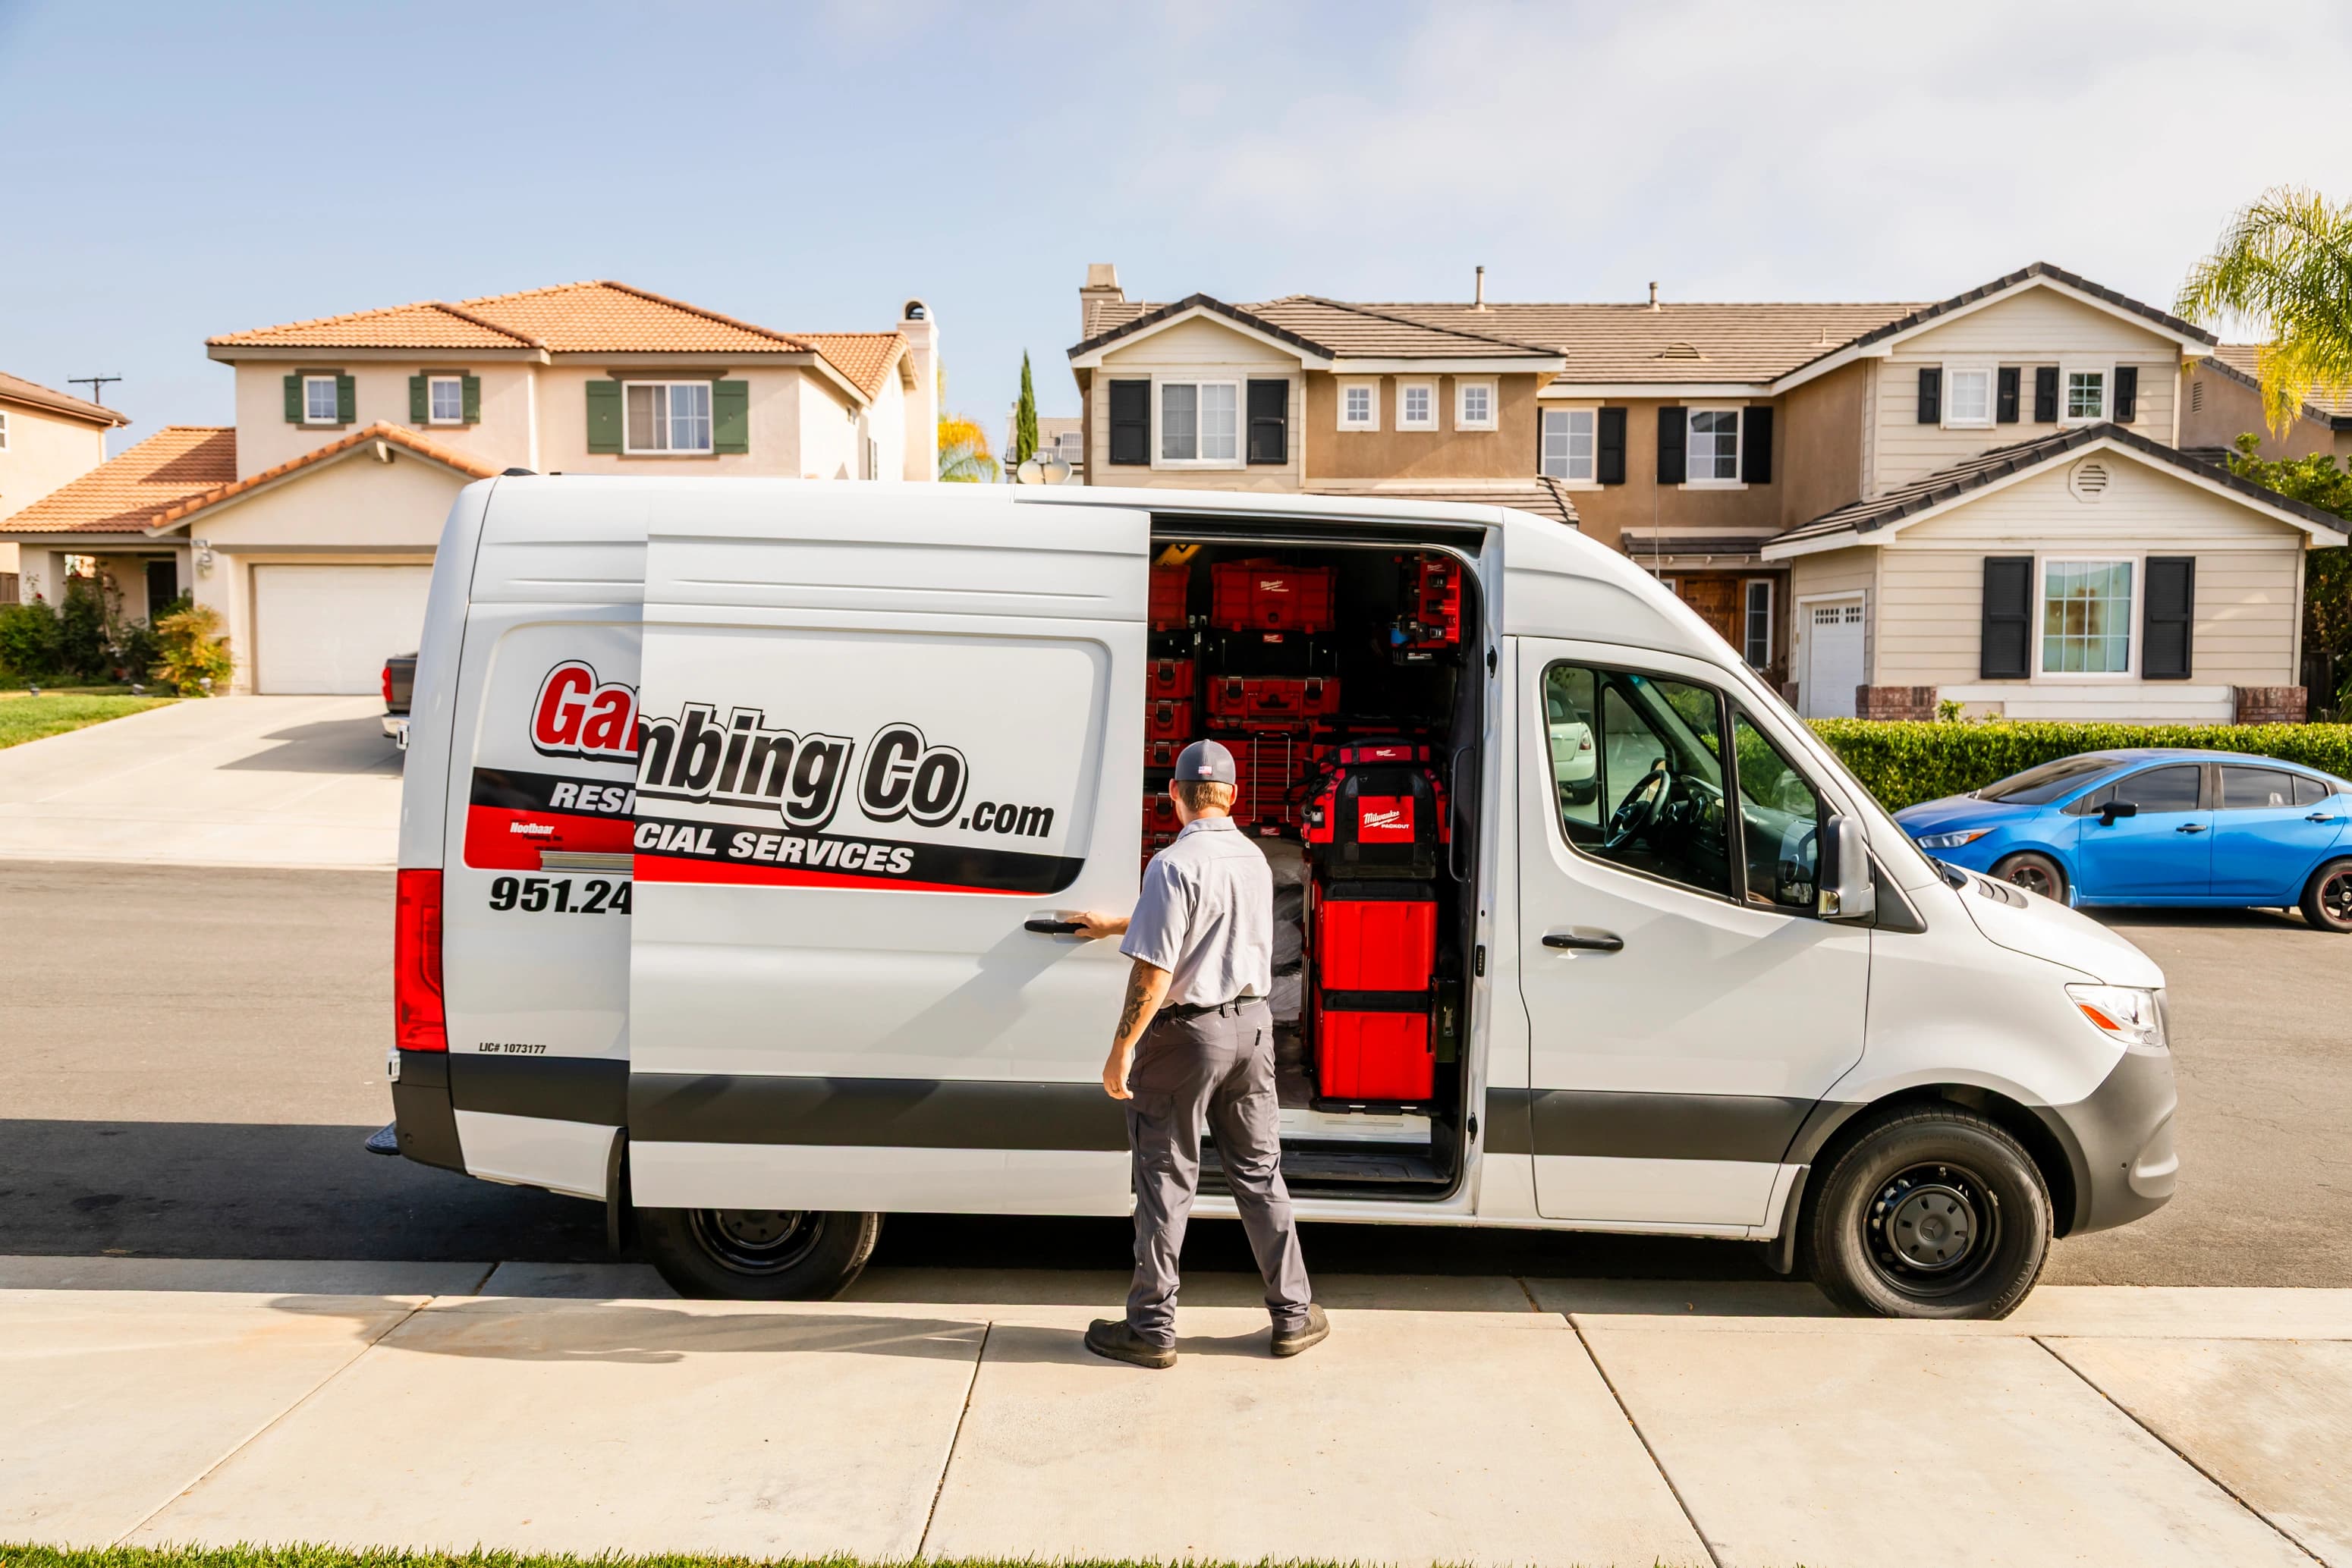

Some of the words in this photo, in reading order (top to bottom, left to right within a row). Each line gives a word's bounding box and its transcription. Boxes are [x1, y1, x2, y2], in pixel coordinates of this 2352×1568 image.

[531, 661, 639, 760] Ga
[549, 781, 637, 815] RESI
[1363, 810, 1401, 825] Milwaukee
[634, 822, 717, 855] CIAL
[728, 831, 914, 875] SERVICES
[489, 876, 632, 915] 951.24
[479, 1042, 501, 1052] LIC#
[504, 1043, 547, 1054] 1073177
